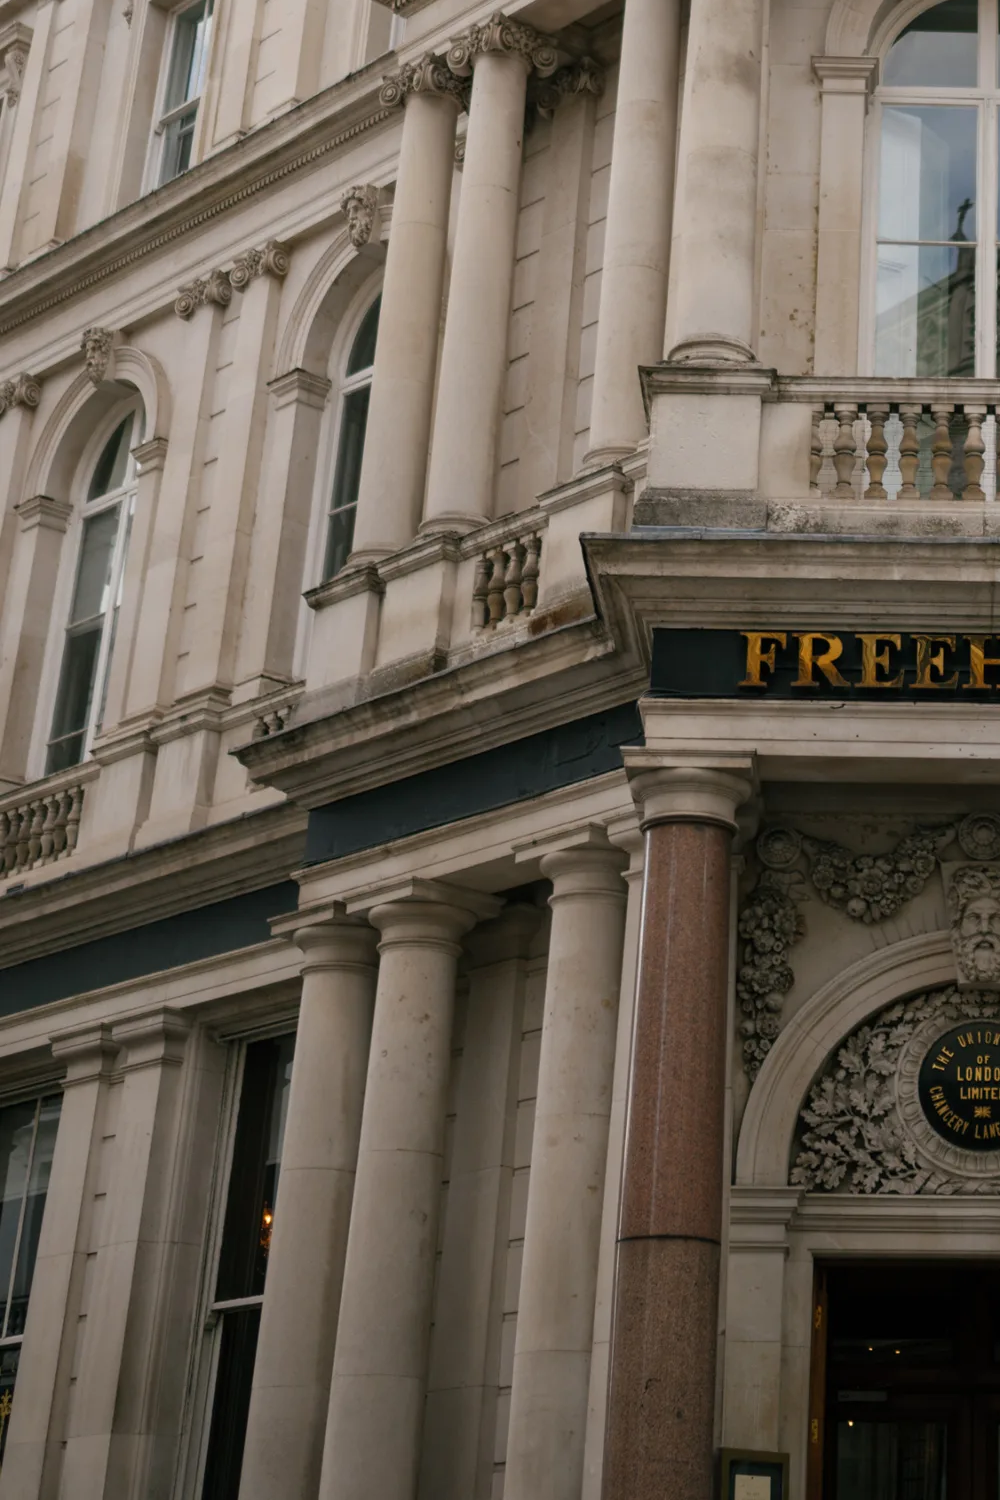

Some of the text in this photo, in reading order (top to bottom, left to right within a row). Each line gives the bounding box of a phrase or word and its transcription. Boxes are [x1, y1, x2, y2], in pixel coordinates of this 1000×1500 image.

[932, 1046, 955, 1072] THE
[957, 1031, 1000, 1048] UNION
[976, 1055, 991, 1065] OF
[929, 1086, 970, 1135] CHANCERY
